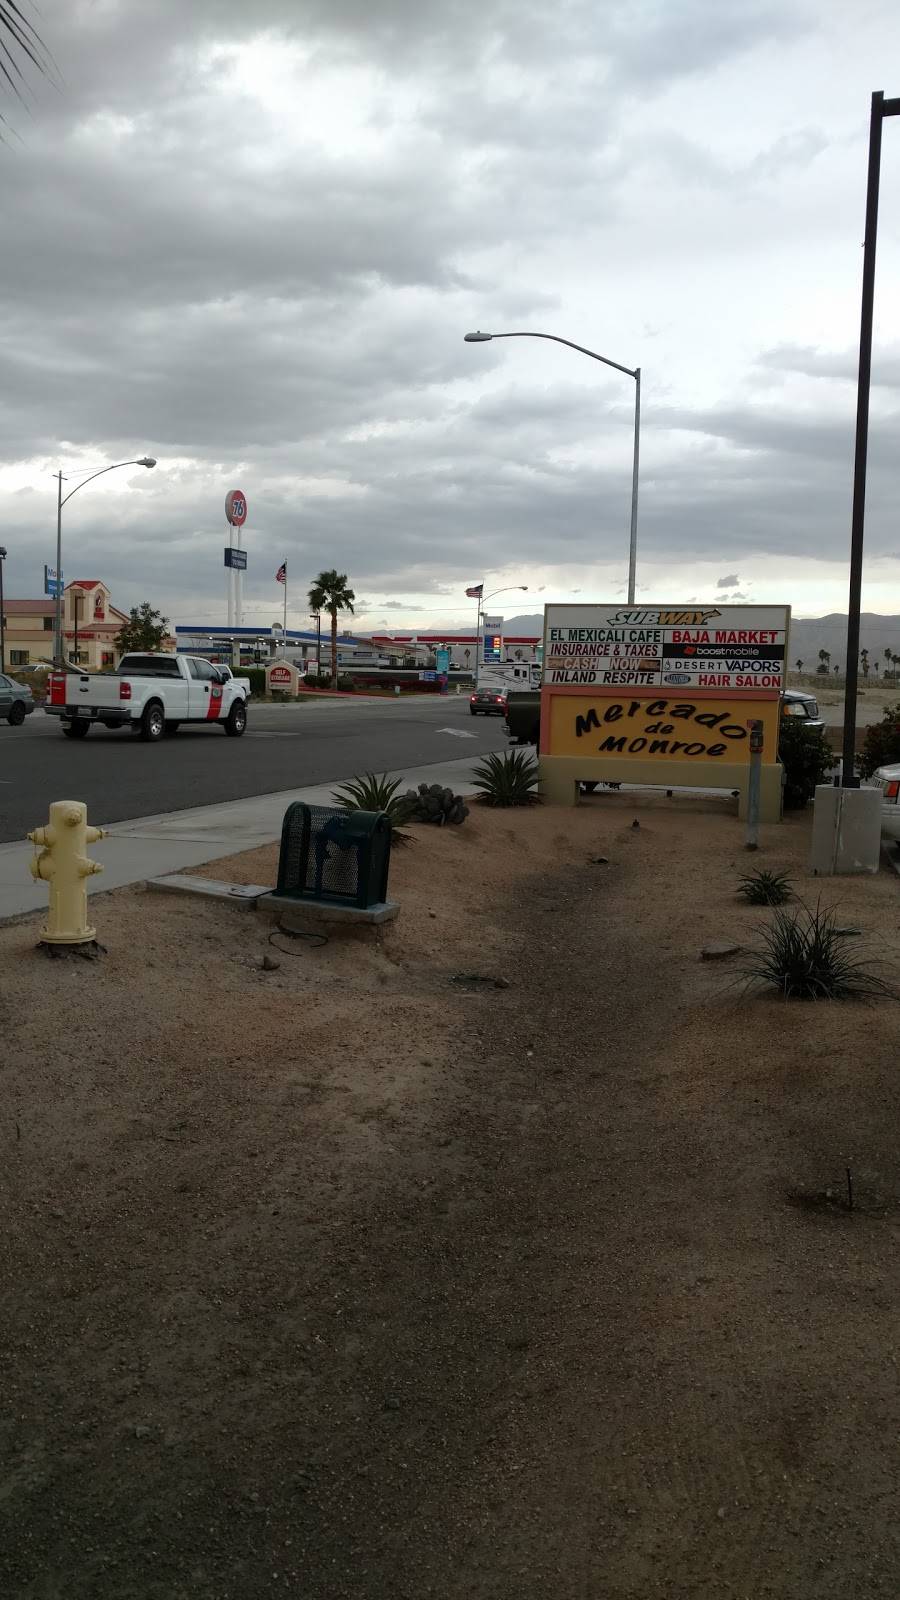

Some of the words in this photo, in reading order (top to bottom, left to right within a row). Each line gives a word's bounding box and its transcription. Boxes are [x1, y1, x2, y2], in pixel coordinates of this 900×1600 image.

[233, 500, 245, 518] 76
[47, 568, 64, 578] Moil
[607, 609, 721, 627] SUBWAY
[550, 629, 565, 641] EL
[568, 630, 625, 642] MEXICALI
[629, 630, 661, 643] CAFE
[672, 630, 710, 643] BAJA
[715, 631, 778, 644] MARKET
[550, 643, 611, 656] INSURANCE
[613, 644, 621, 656] &
[624, 644, 659, 657] TAXES
[696, 646, 760, 656] boostmobile
[563, 657, 600, 670] CASH
[609, 658, 642, 671] NOW
[675, 661, 723, 670] DESERT
[725, 660, 781, 673] VAPORS
[551, 670, 597, 683] INLAND
[602, 672, 655, 685] RESPITE
[698, 674, 731, 687] HAIR
[735, 675, 782, 688] SALON
[575, 700, 748, 739] Mercado
[644, 721, 675, 735] de
